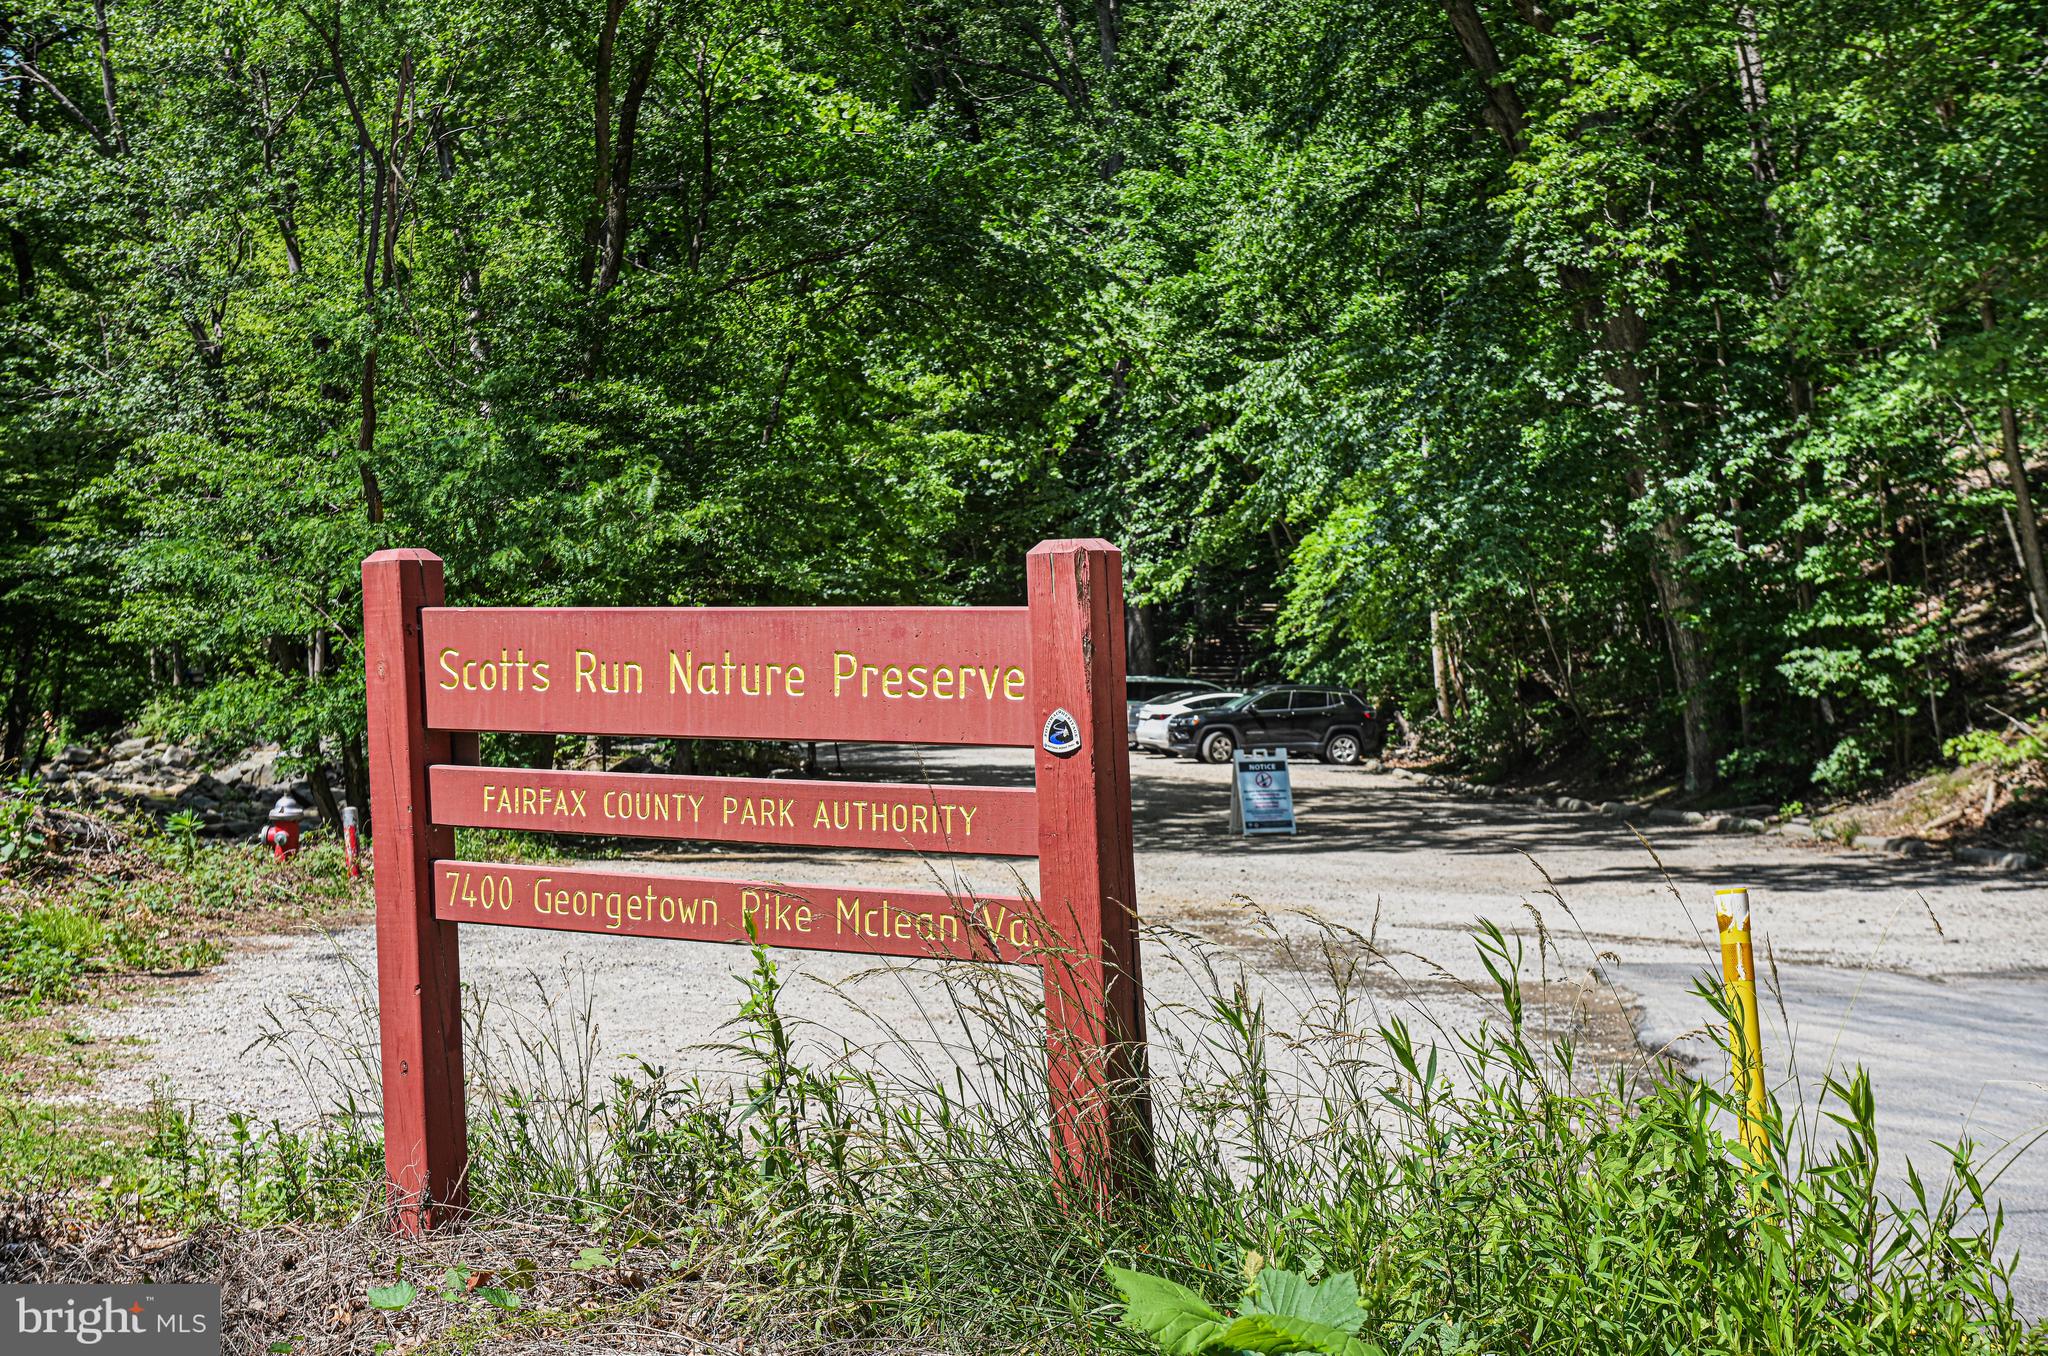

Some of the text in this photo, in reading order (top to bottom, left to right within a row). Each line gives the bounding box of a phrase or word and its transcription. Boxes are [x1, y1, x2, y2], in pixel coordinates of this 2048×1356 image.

[438, 647, 1026, 701] Scotts Run Nature Preserve
[1248, 763, 1276, 771] NOTICE
[483, 785, 978, 835] FAIRFAX COUNTY PARK AUTHORITY
[446, 871, 513, 911] 7400
[533, 877, 718, 929] Georgetown
[740, 890, 813, 932] Pike
[836, 896, 958, 942] Mclean
